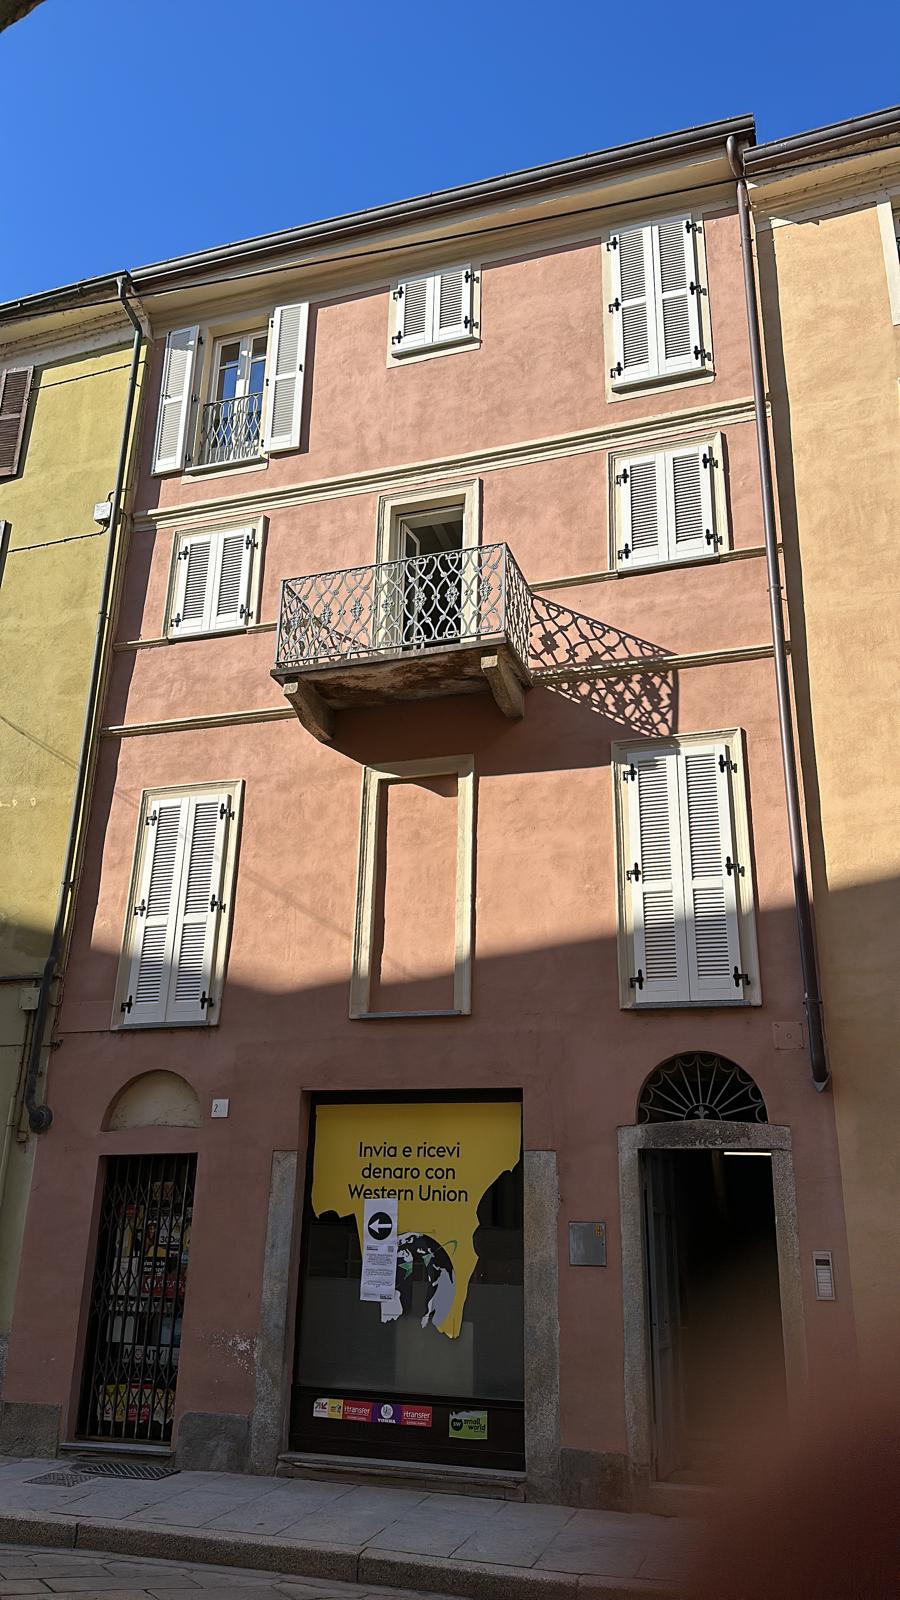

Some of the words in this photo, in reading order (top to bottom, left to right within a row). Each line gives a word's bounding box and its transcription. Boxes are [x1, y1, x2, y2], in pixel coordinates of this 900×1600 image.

[359, 1141, 397, 1158] Invia
[402, 1146, 412, 1158] e
[416, 1141, 460, 1158] ricevi
[361, 1163, 420, 1180] denaro
[425, 1167, 456, 1180] con
[348, 1184, 414, 1200] Western
[419, 1185, 468, 1202] Union
[464, 1417, 481, 1425] small
